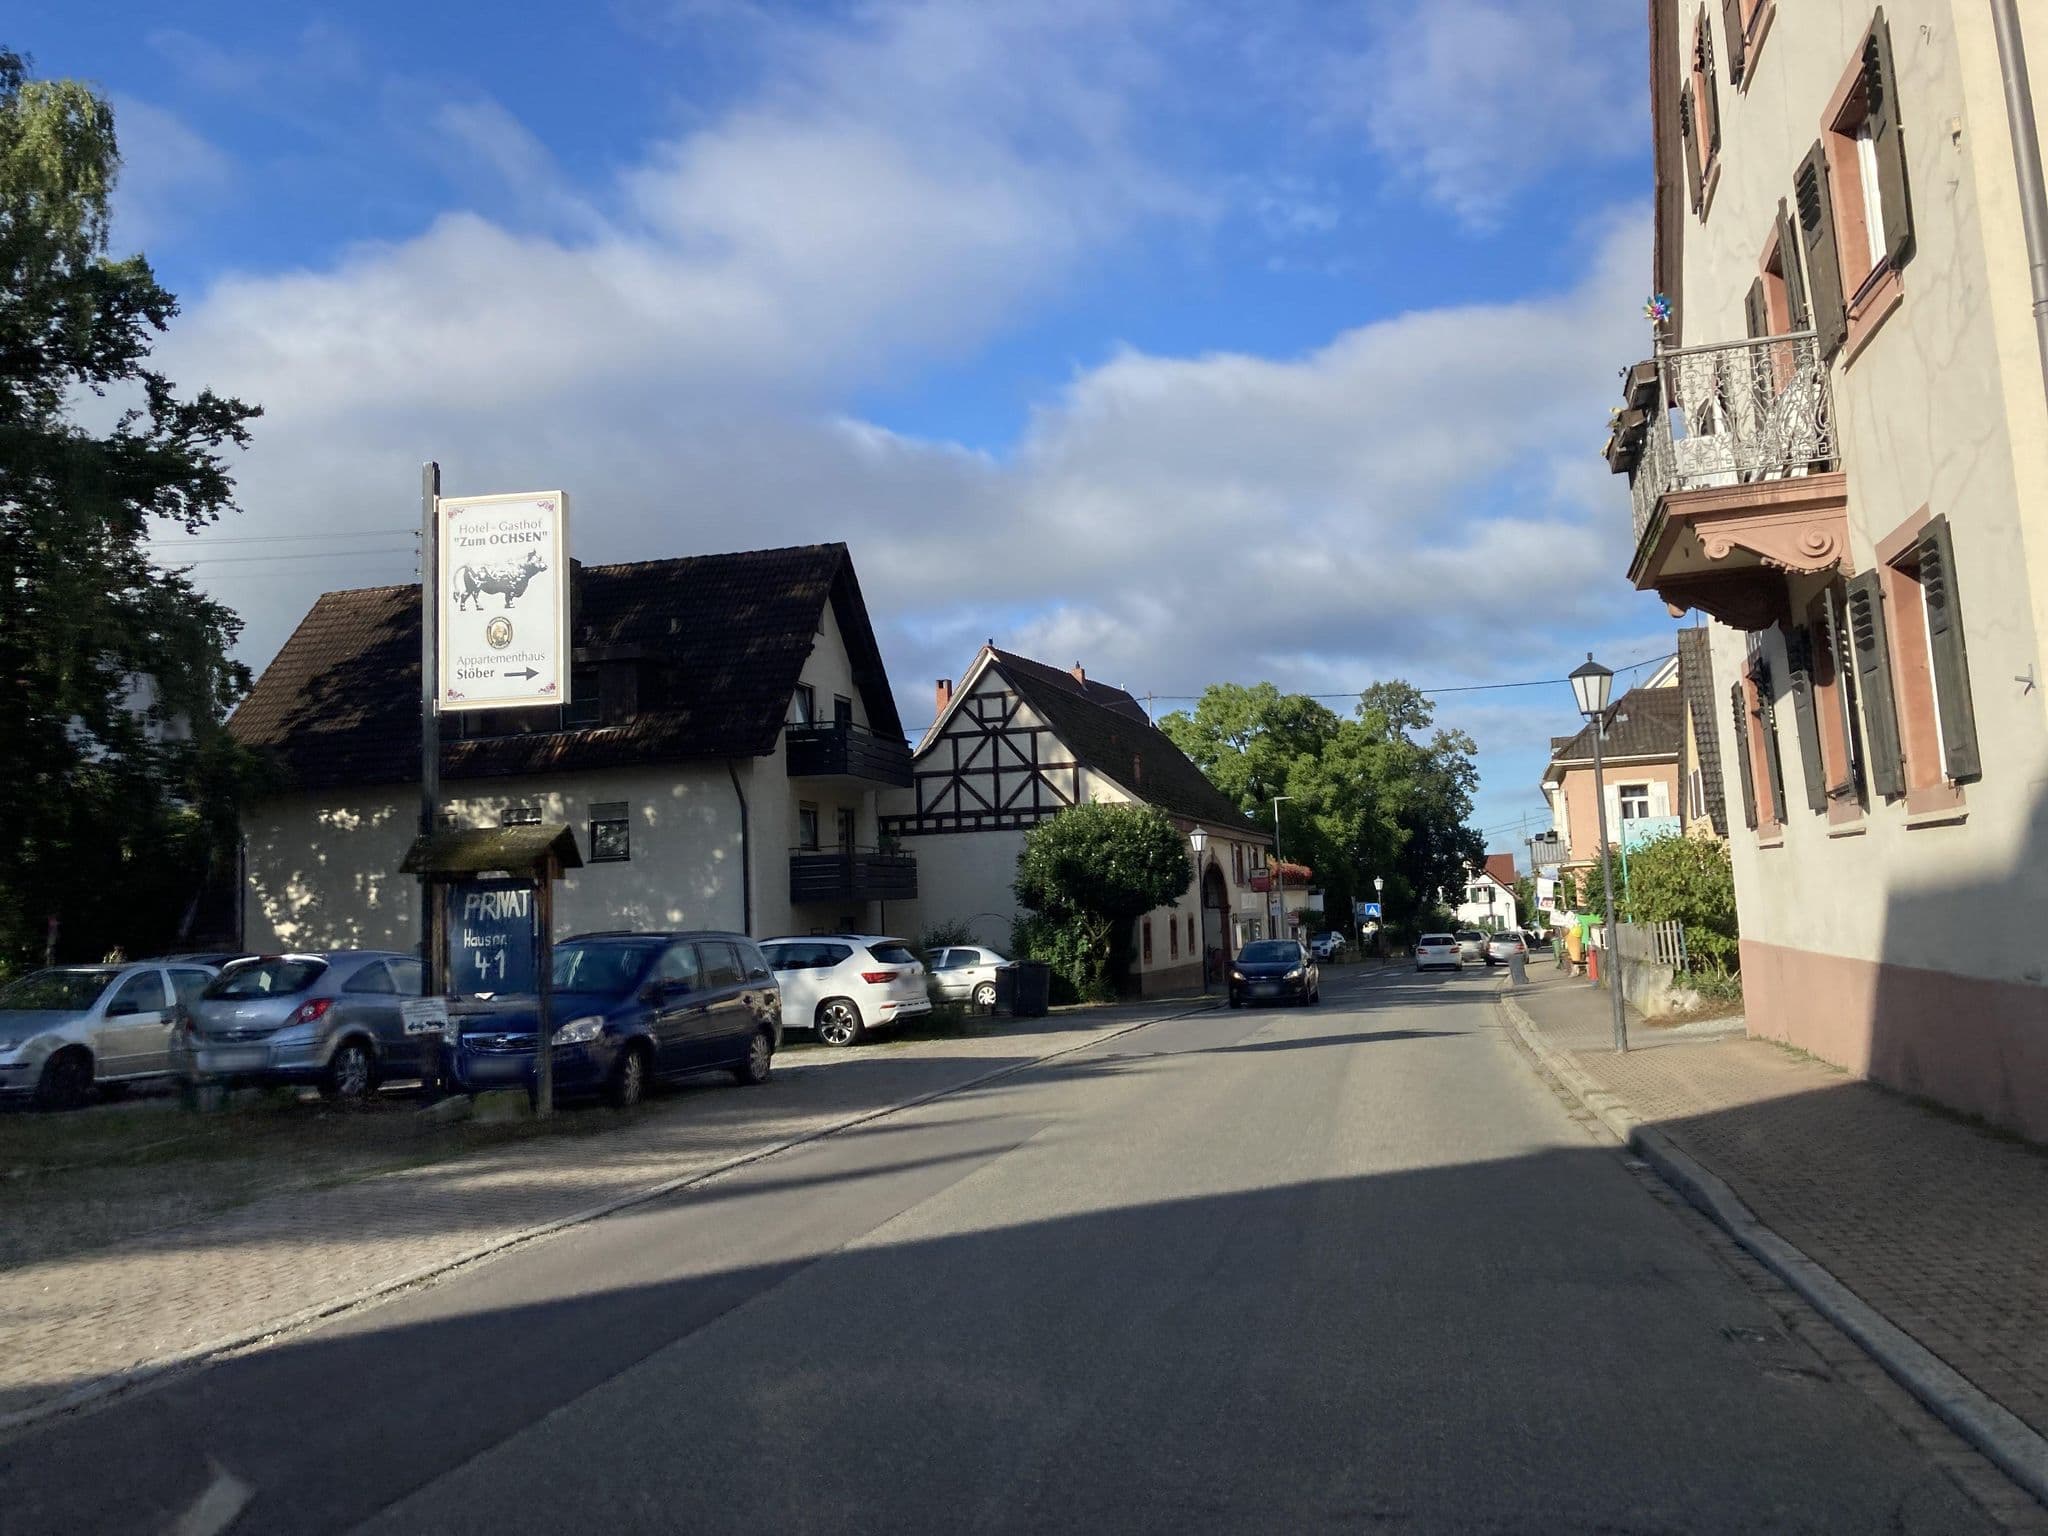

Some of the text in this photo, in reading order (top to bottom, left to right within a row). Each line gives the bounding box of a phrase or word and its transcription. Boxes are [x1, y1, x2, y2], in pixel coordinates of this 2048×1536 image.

[459, 522, 488, 534] Hotel
[498, 520, 542, 532] Gasthof
[454, 531, 547, 547] "Zum OCHSEN"
[457, 650, 545, 667] Appartementhaus
[457, 667, 495, 680] Stöber
[464, 890, 531, 921] PRIVAT
[475, 949, 505, 980] 41
